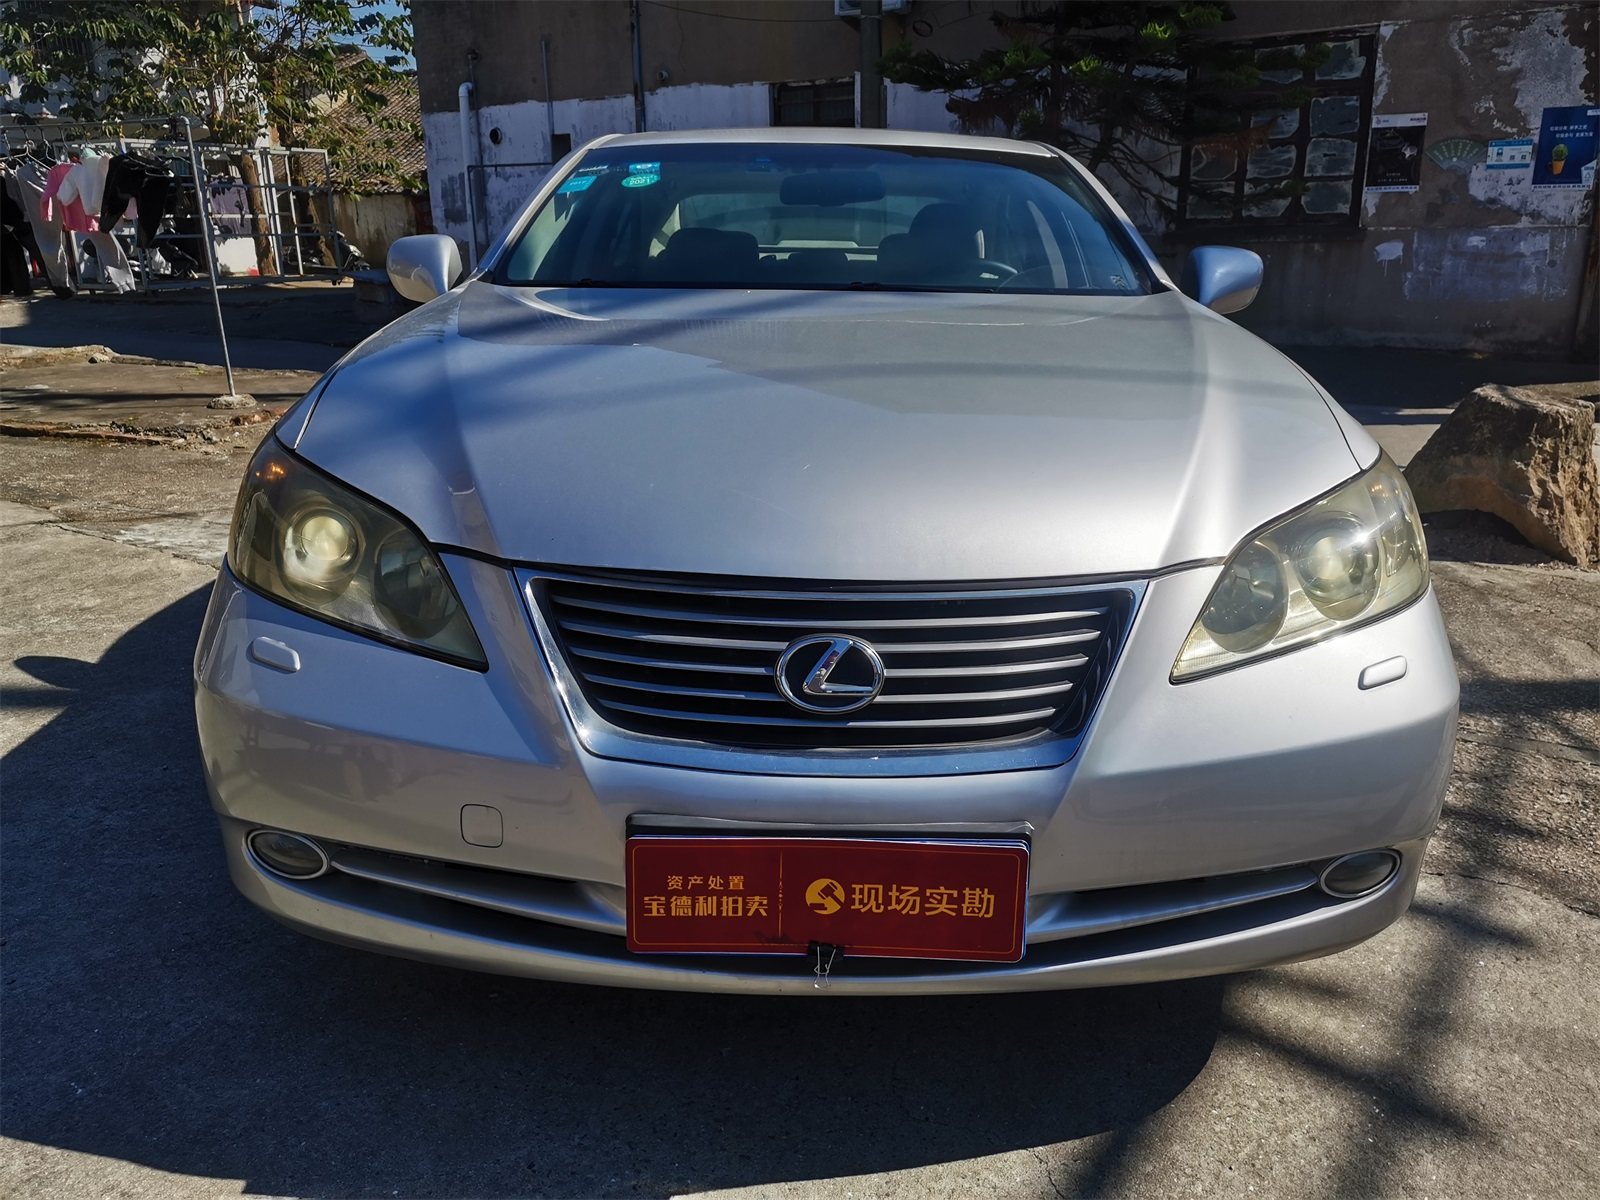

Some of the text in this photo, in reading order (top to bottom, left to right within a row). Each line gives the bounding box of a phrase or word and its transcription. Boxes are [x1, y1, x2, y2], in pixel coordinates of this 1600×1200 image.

[667, 875, 745, 891] 资产处置
[643, 895, 769, 917] 宝德利拍卖
[850, 883, 996, 919] 现场实勘
